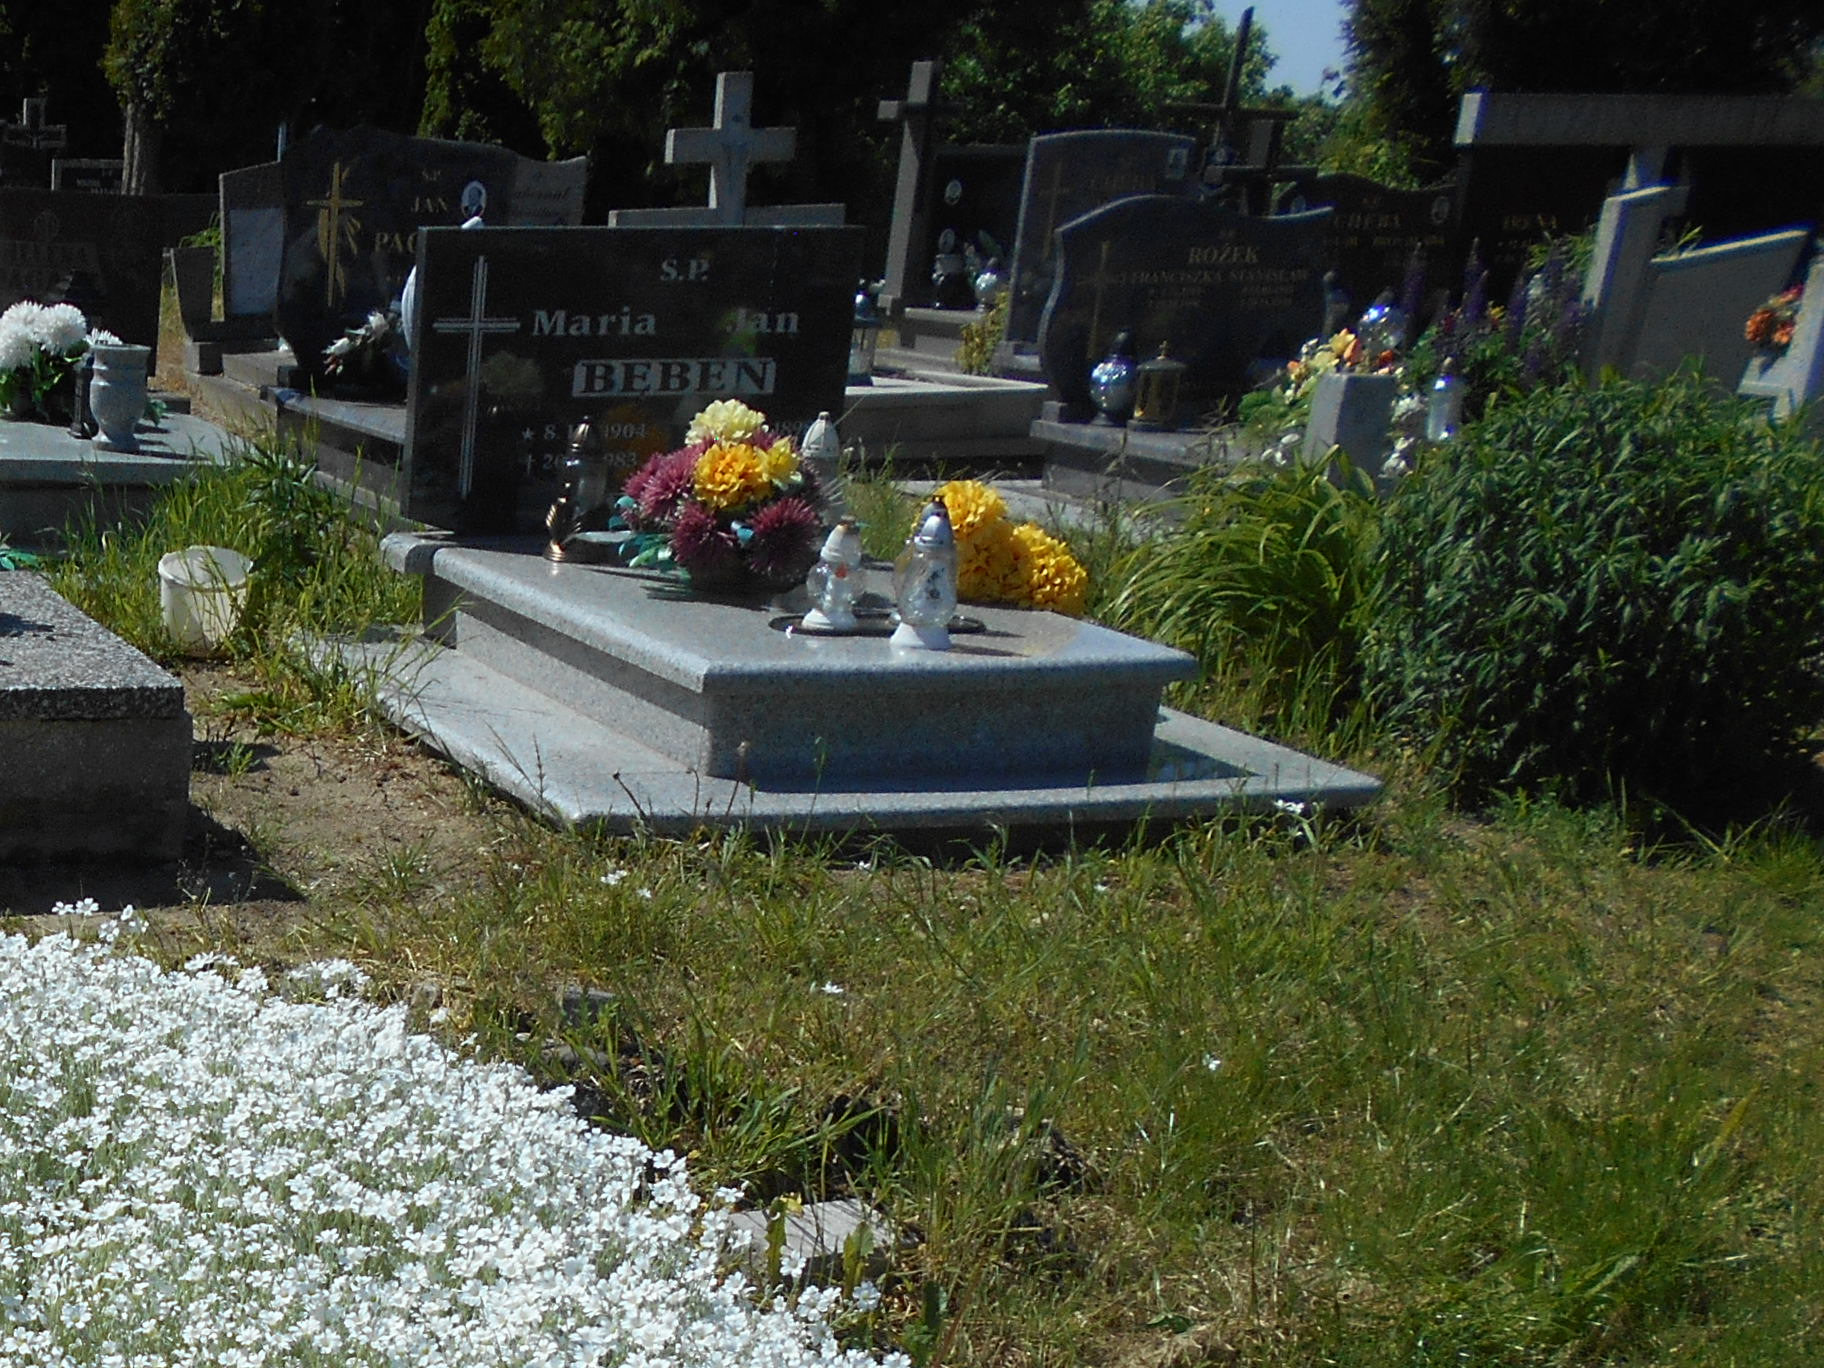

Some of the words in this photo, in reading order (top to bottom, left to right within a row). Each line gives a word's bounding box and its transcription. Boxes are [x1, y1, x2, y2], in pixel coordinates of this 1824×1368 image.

[410, 196, 448, 214] JAN
[532, 303, 657, 337] Maria
[724, 307, 800, 336] Jan
